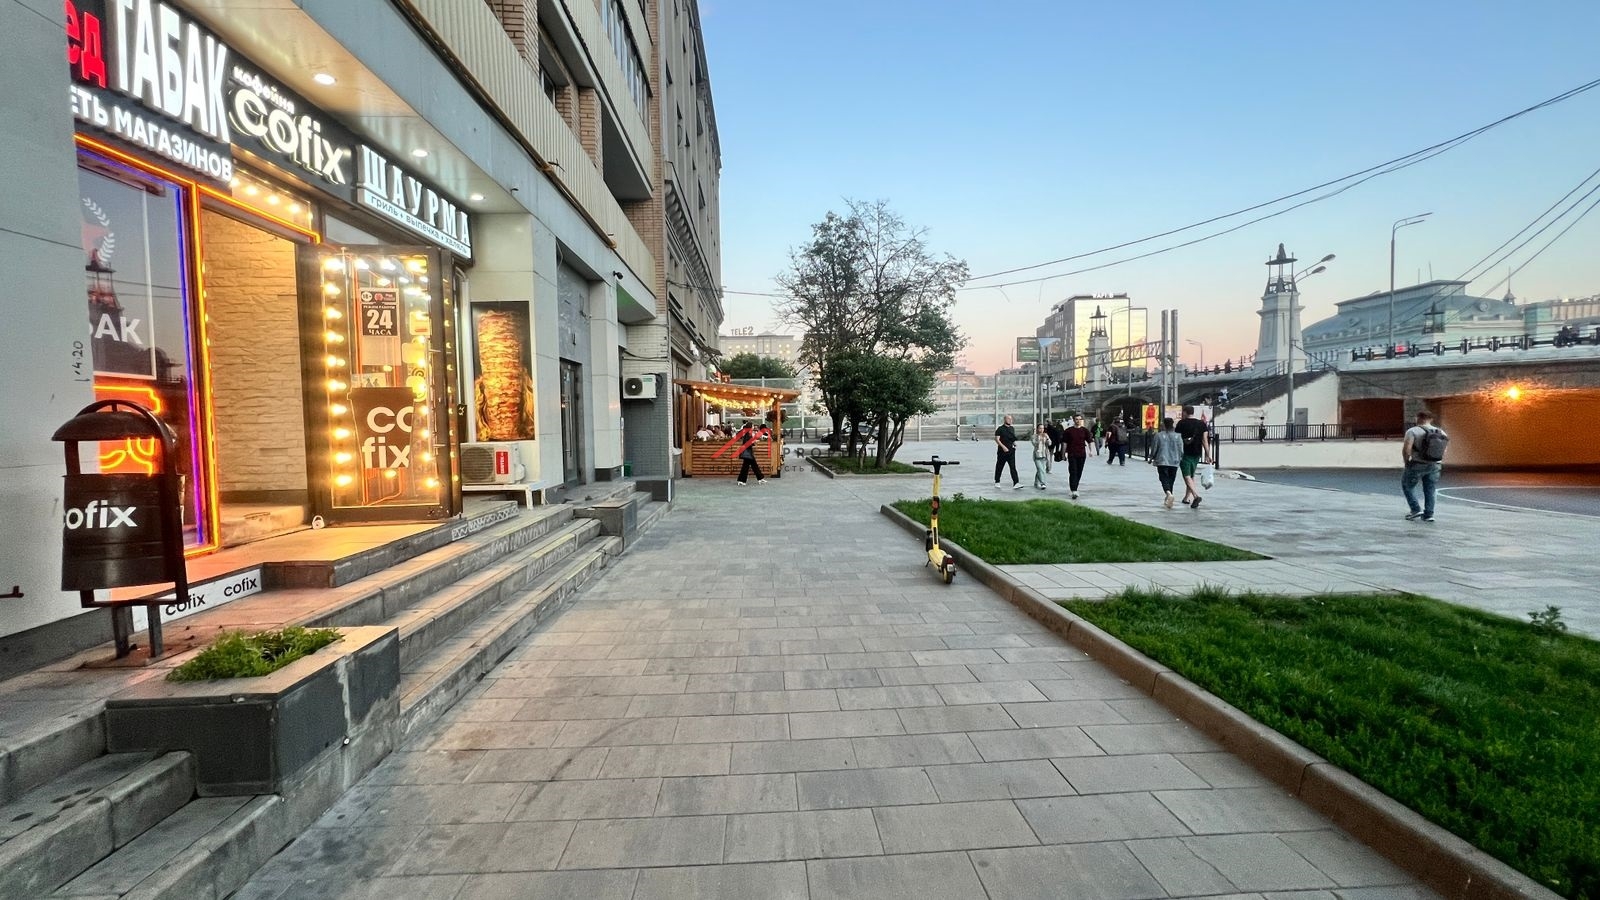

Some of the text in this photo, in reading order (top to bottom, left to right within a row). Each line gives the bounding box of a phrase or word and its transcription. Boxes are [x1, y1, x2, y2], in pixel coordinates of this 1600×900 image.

[115, 0, 231, 143] ТАБАК
[233, 66, 295, 115] кофейня
[114, 106, 233, 182] МАГАЗИНОВ
[234, 88, 346, 185] cofix
[361, 144, 471, 247] ШАУРМА
[89, 313, 143, 345] АК
[367, 309, 392, 329] 24
[731, 326, 754, 336] TELE2
[64, 500, 138, 530] ofix
[223, 577, 258, 597] cofix
